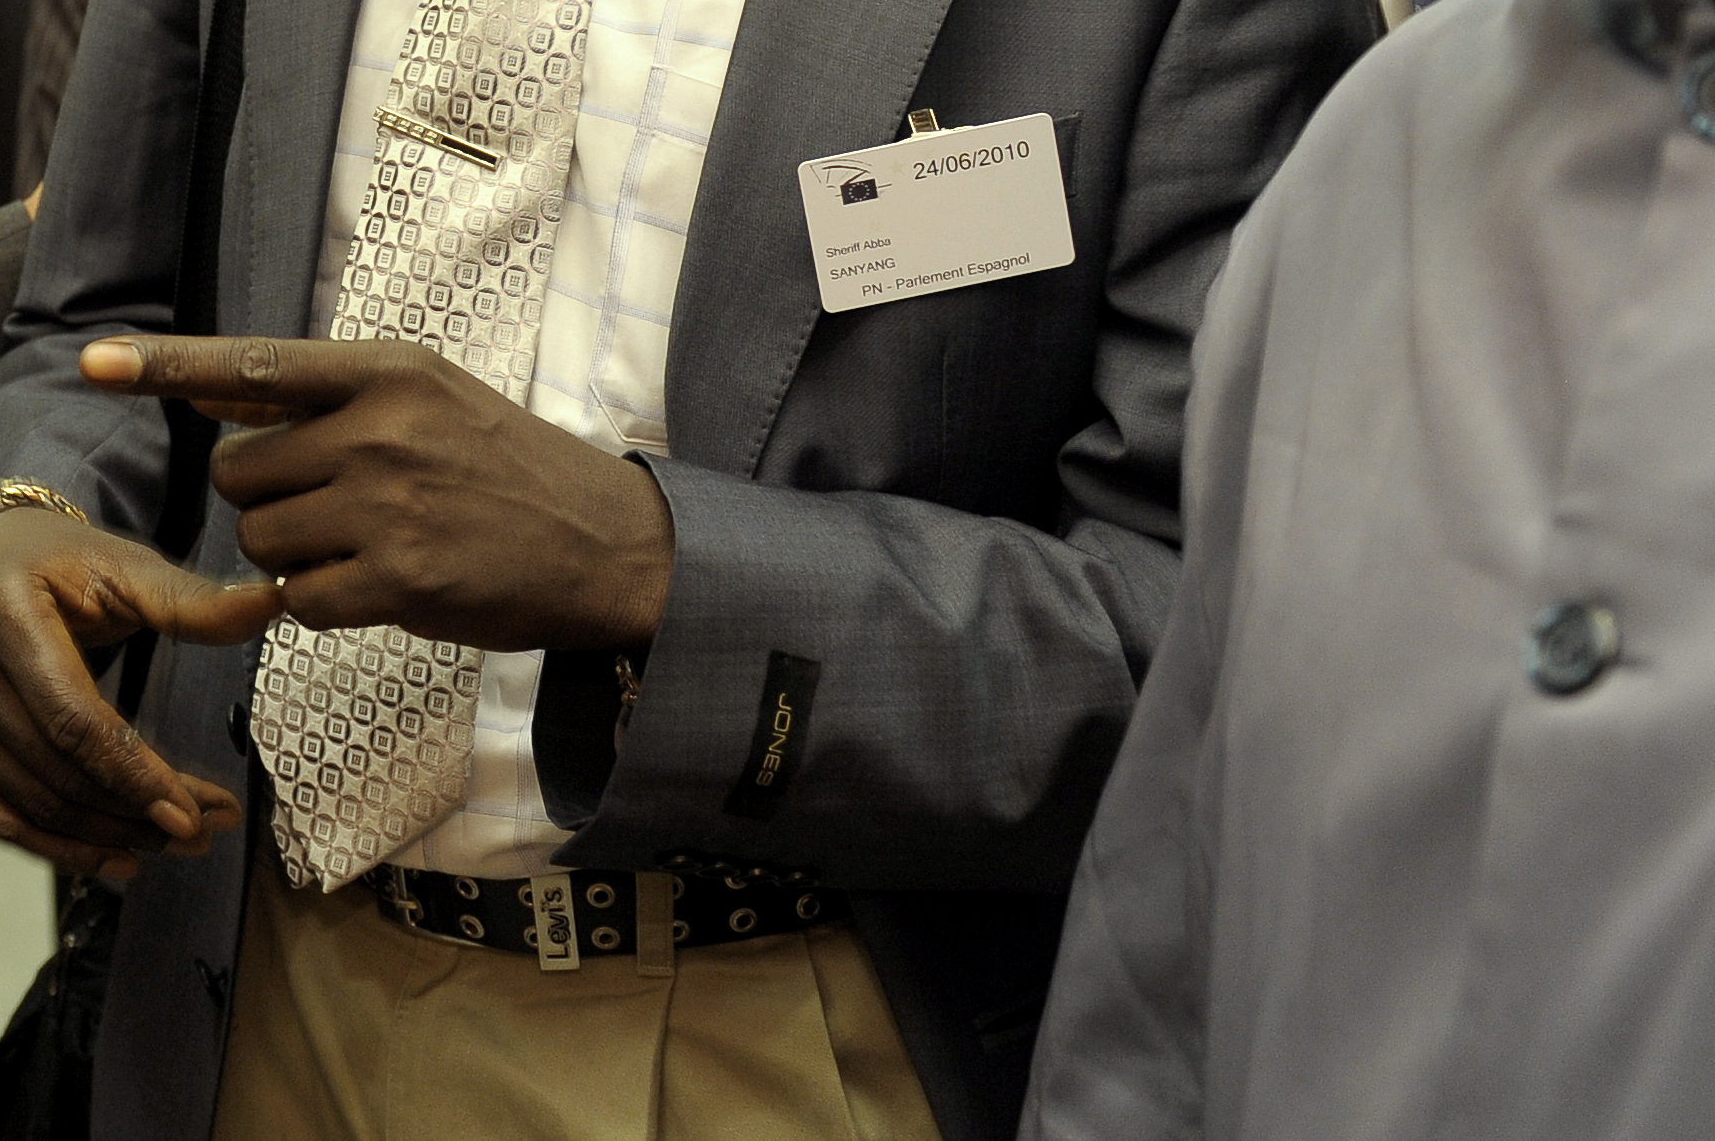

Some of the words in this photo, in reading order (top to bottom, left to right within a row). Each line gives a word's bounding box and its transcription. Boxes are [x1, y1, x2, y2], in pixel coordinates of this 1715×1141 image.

[912, 140, 1031, 180] 24/06/2010
[825, 243, 861, 258] Sheriff
[863, 238, 892, 251] Abba
[829, 257, 897, 280] SANYANG
[861, 282, 884, 297] PN
[895, 266, 965, 290] Parlement
[967, 252, 1031, 275] Espagnol
[755, 692, 793, 787] JONES
